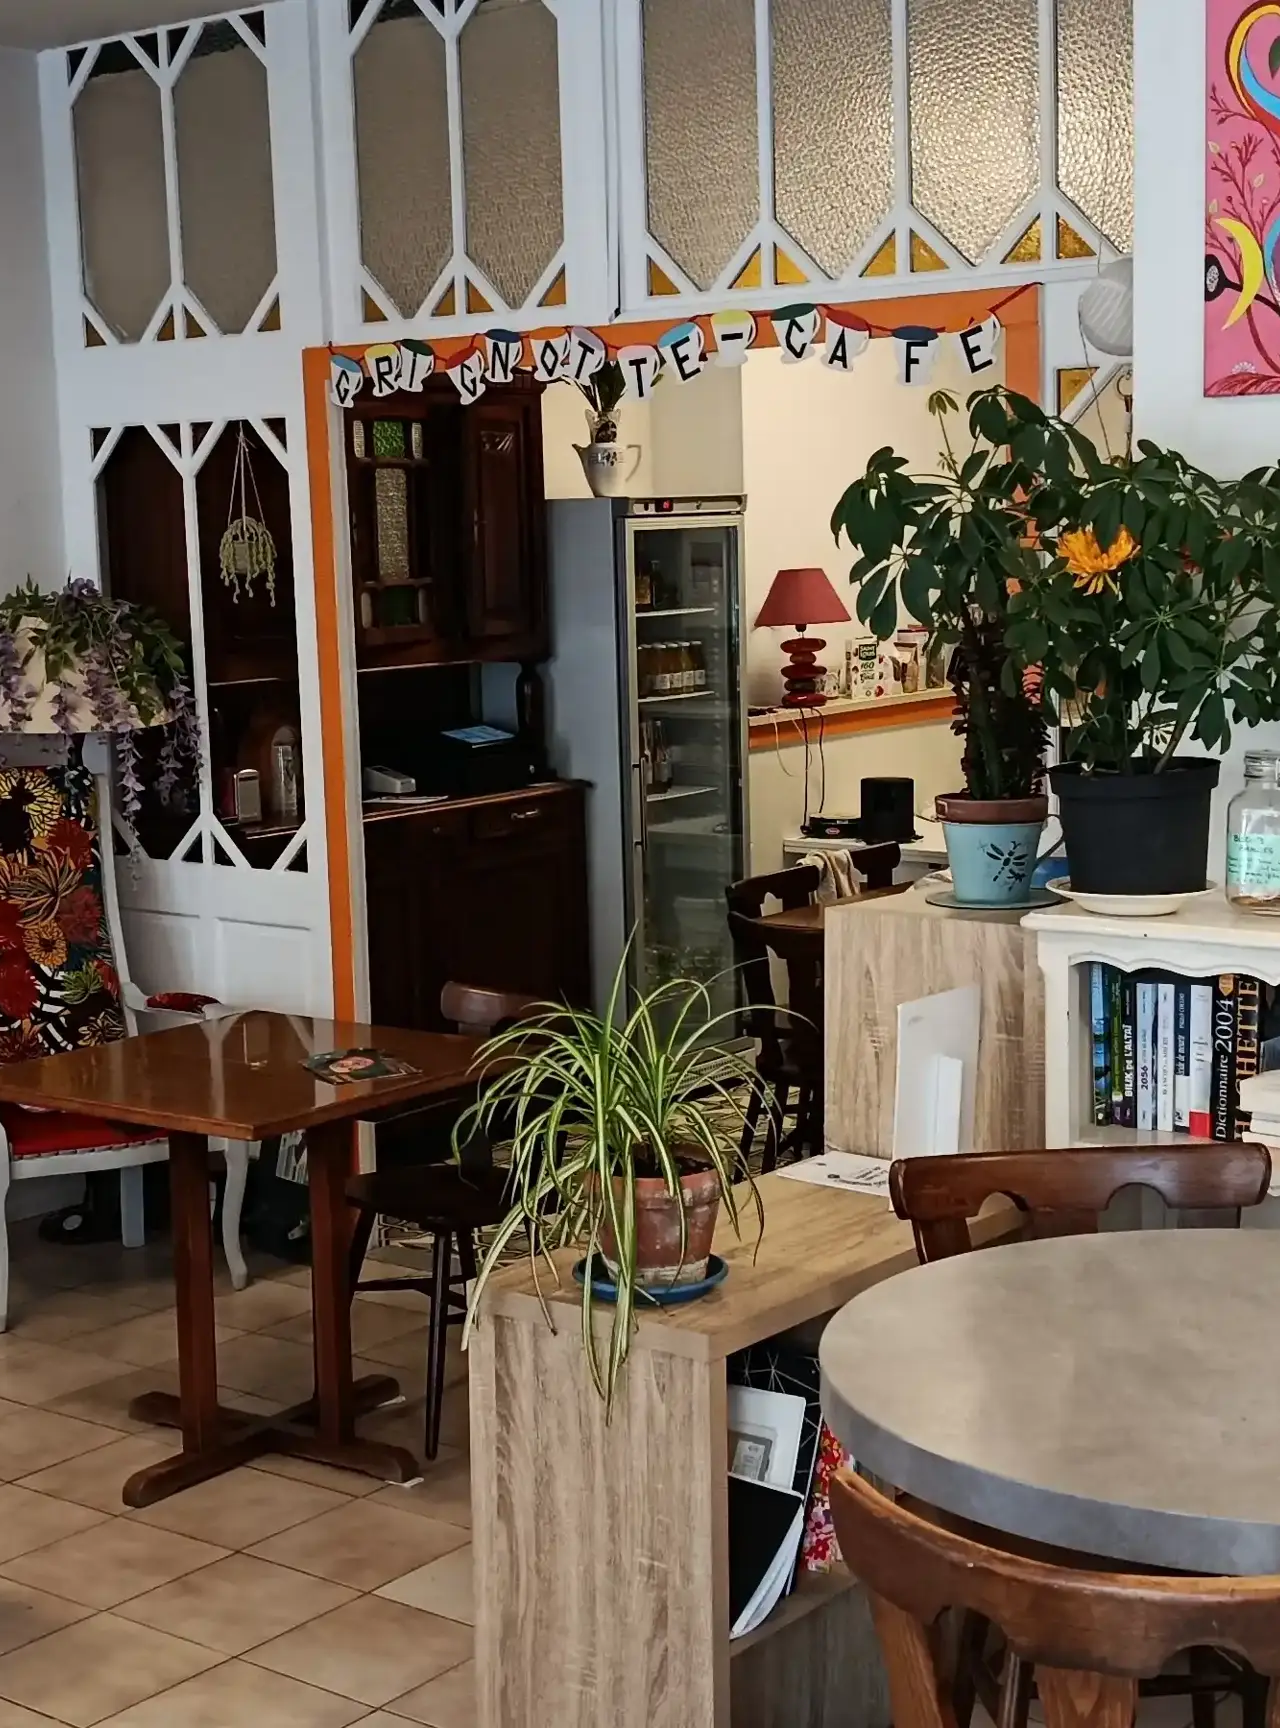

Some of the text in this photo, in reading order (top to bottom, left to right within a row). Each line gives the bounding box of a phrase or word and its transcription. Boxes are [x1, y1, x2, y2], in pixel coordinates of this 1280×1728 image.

[1140, 1065, 1149, 1090] 2056
[1214, 998, 1234, 1139] Dictionnaire 2004
